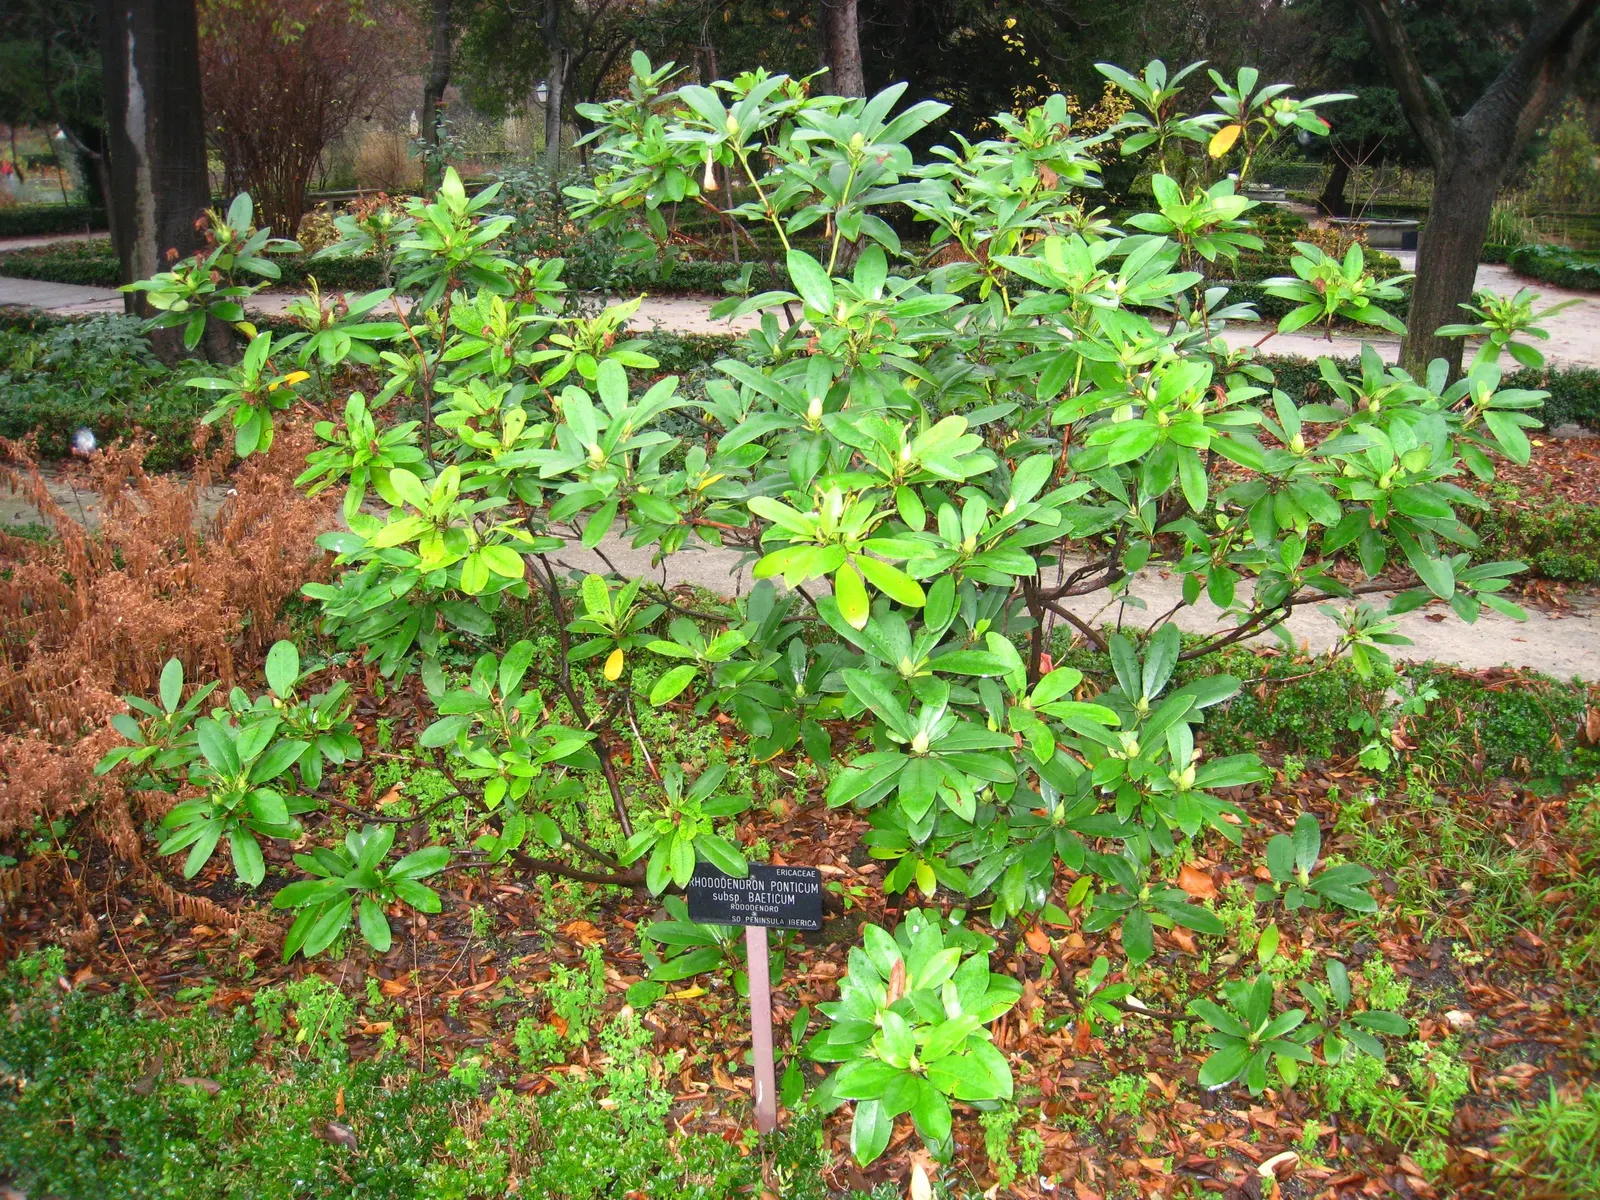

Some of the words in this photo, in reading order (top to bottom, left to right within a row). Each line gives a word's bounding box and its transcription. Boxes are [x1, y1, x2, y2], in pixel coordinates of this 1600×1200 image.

[776, 868, 816, 878] ERICACEAE
[689, 877, 765, 891] RHODODENDRON
[771, 881, 819, 894] PONTICUM
[748, 892, 795, 905] BAETICUM
[730, 903, 779, 913] RODODENDRO
[732, 915, 741, 923] SO
[745, 916, 785, 925] PENINSULA
[788, 919, 817, 927] IBERICA
